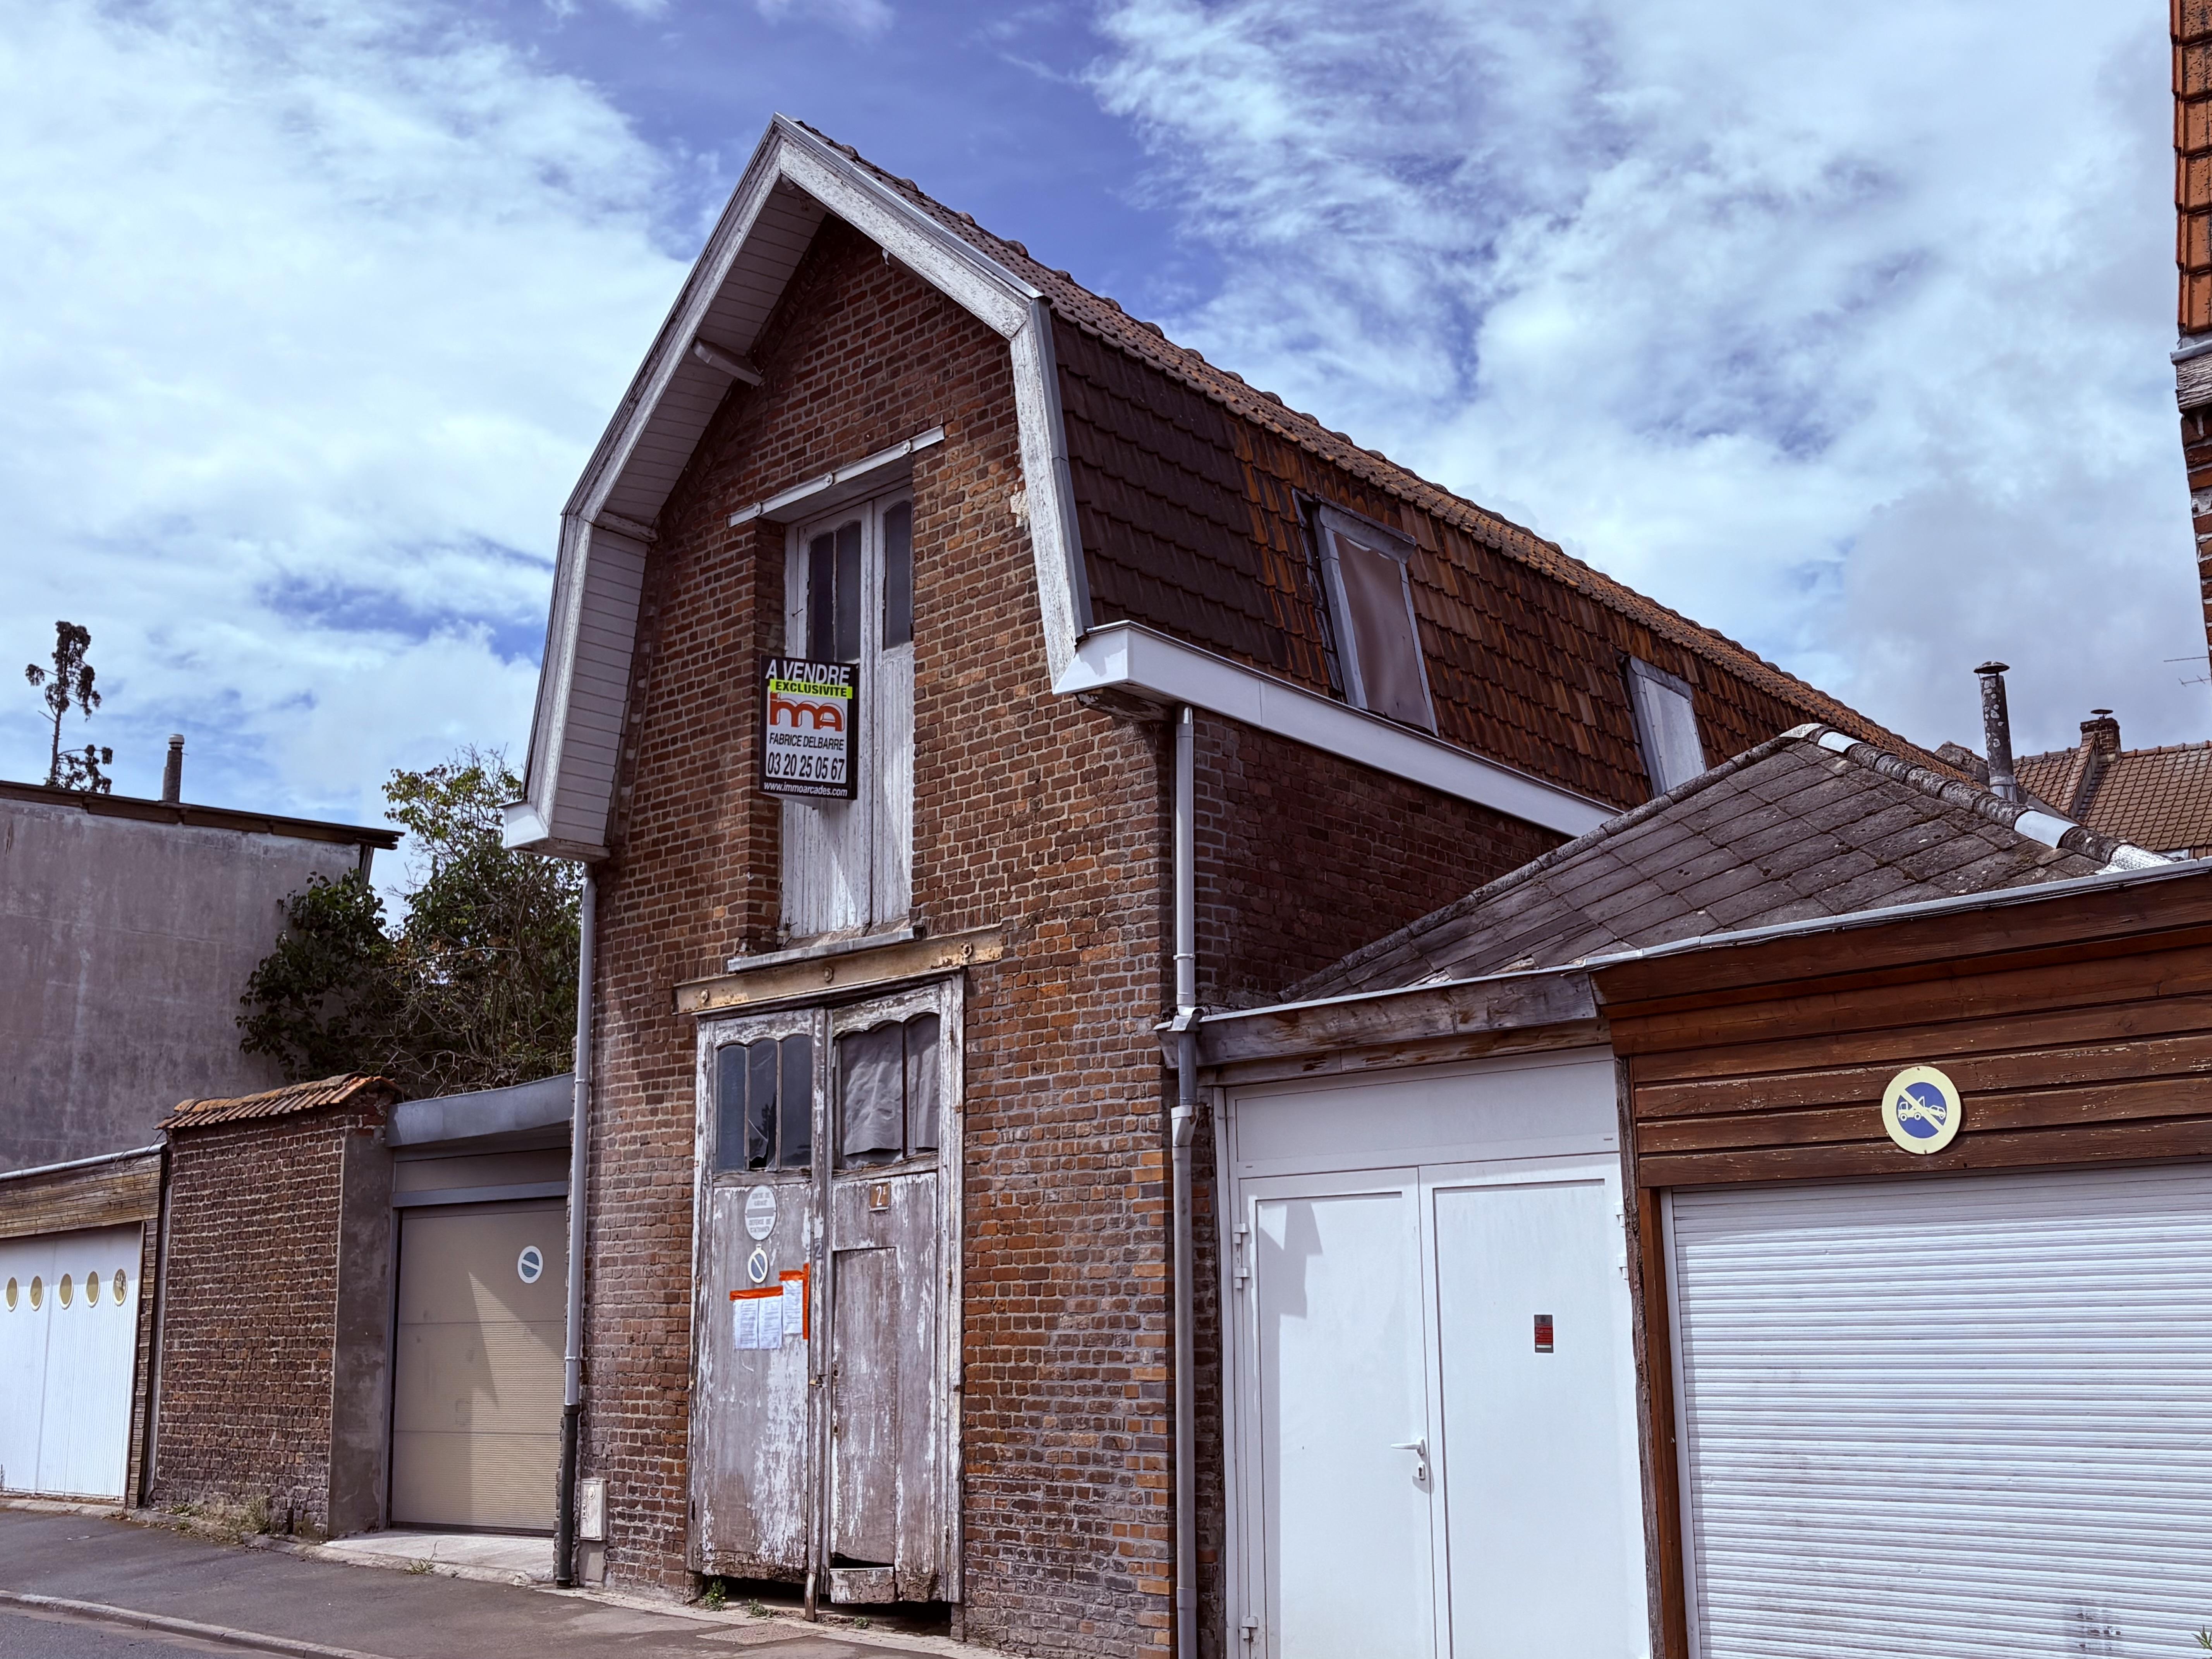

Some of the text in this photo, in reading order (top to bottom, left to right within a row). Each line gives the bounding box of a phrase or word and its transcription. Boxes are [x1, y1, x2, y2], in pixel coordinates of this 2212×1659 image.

[765, 659, 851, 686] A VENDRE
[775, 681, 847, 697] EXCLUSIVITE
[769, 732, 844, 750] FABRICE DELBARRE
[768, 752, 845, 781] 03 20 25 05 67
[764, 781, 848, 797] www.immoarcades.com
[814, 1242, 823, 1258] 2
